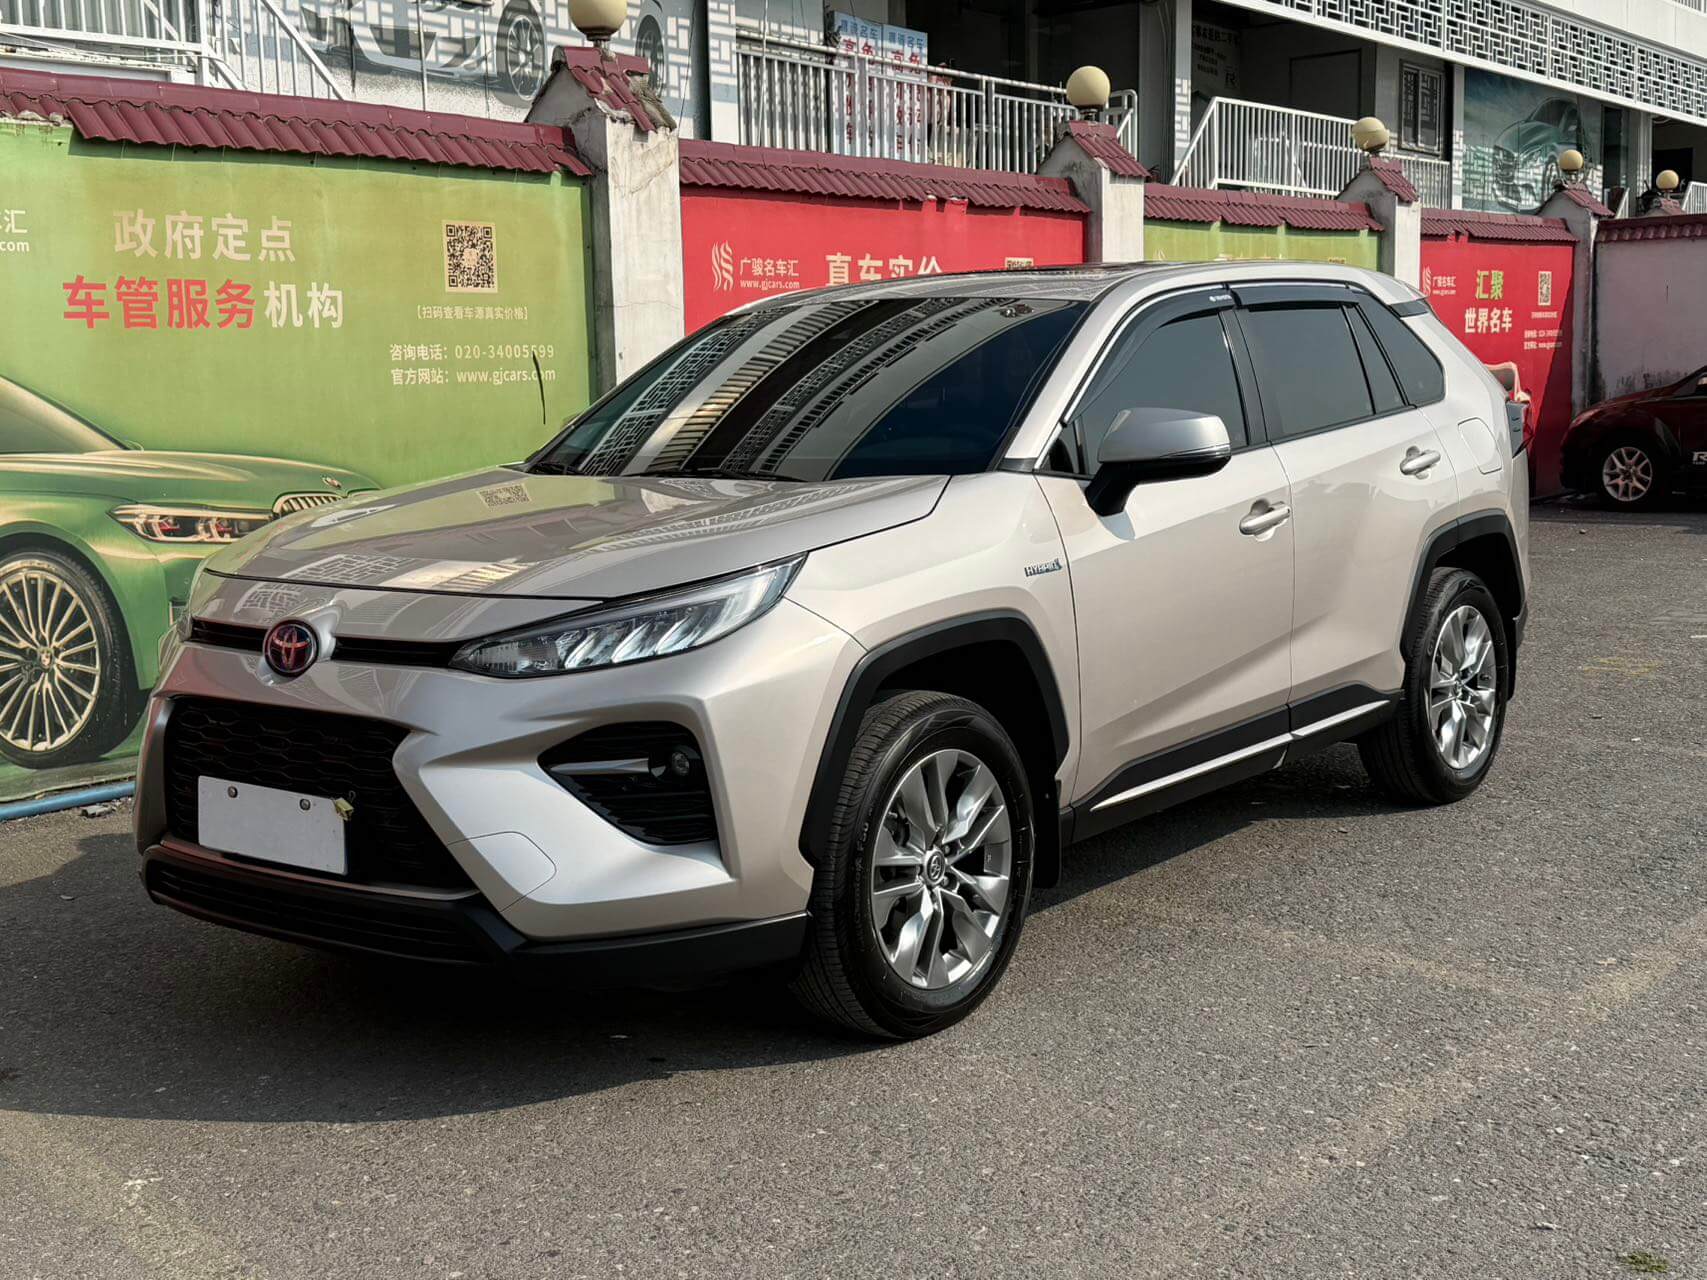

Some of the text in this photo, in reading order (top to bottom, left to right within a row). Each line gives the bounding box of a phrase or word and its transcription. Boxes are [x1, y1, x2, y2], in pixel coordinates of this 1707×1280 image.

[0, 209, 28, 233] 汇
[113, 208, 296, 262] 政府定点
[739, 257, 800, 277] 广骏名车汇
[1475, 270, 1504, 300] 汇聚
[62, 274, 346, 330] 车管服务机构
[1464, 306, 1513, 334] 世界名车
